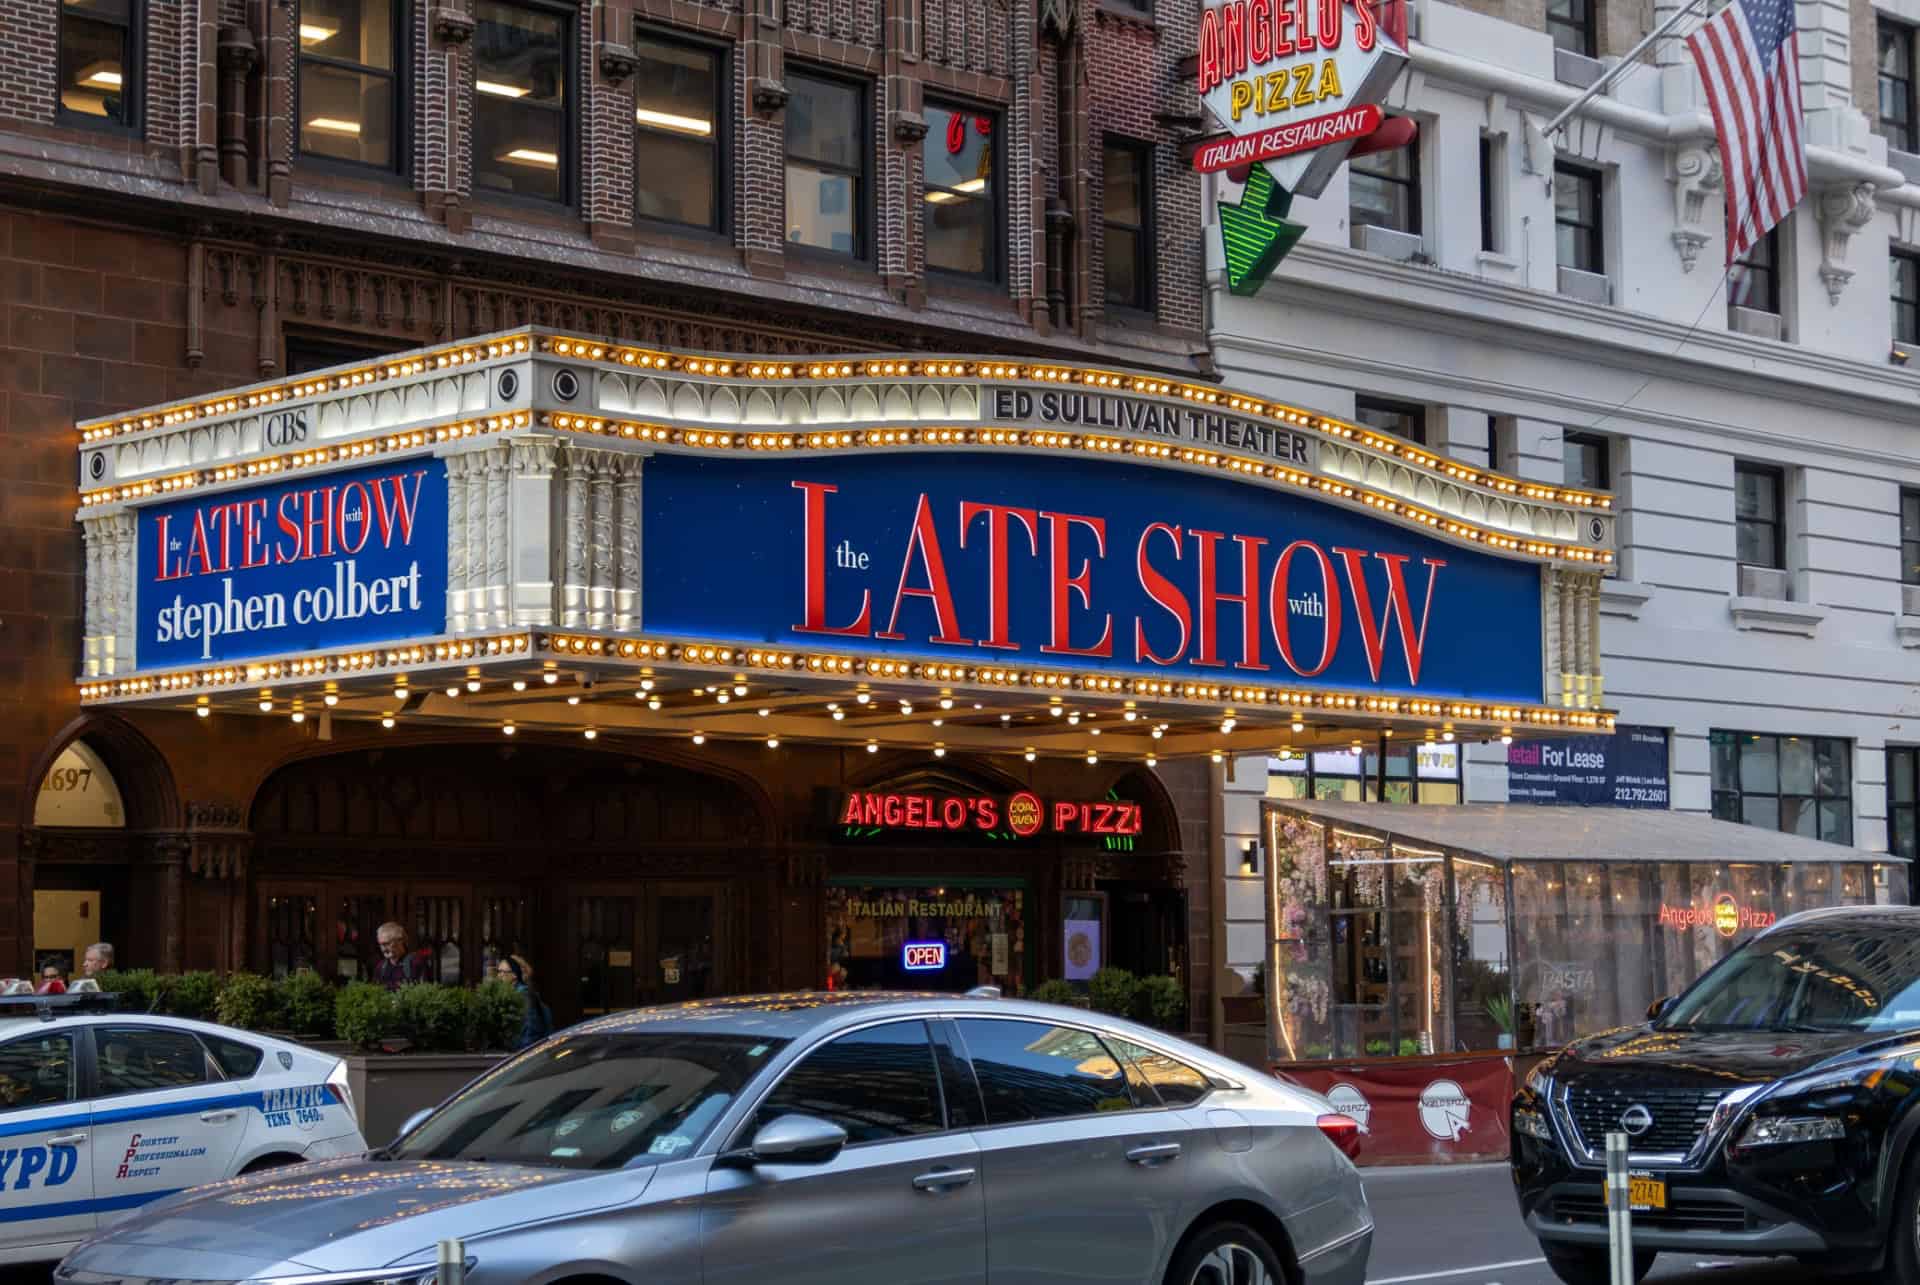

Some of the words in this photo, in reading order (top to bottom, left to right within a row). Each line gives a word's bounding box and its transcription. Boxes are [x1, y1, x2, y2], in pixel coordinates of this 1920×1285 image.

[1199, 0, 1377, 95] ANGELOS
[1231, 58, 1343, 120] PIZZA
[1202, 138, 1256, 168] ITALIAN
[1260, 110, 1368, 154] RESTAURANT
[267, 410, 308, 447] CBS
[994, 389, 1033, 419] ED
[1039, 391, 1181, 436] SULLIVAN
[1185, 411, 1308, 464] THEATER
[275, 470, 428, 564] SHOW
[345, 508, 363, 523] with
[154, 498, 269, 582] LATE
[170, 537, 182, 551] the
[836, 541, 870, 570] the
[791, 480, 1114, 657] LATE
[156, 577, 289, 660] stephen
[293, 559, 422, 625] colbert
[1135, 522, 1448, 686] SHOW
[1288, 593, 1323, 618] with
[1541, 745, 1564, 767] For
[1566, 747, 1604, 769] Lease
[846, 792, 999, 829] ANGELO'S
[1010, 802, 1037, 813] COAL
[1010, 814, 1037, 825] OVEN
[847, 898, 904, 917] ITALIAN
[908, 898, 1001, 917] RESTAURANT
[907, 948, 943, 966] OPEN
[263, 1086, 323, 1112] TRAFFIC
